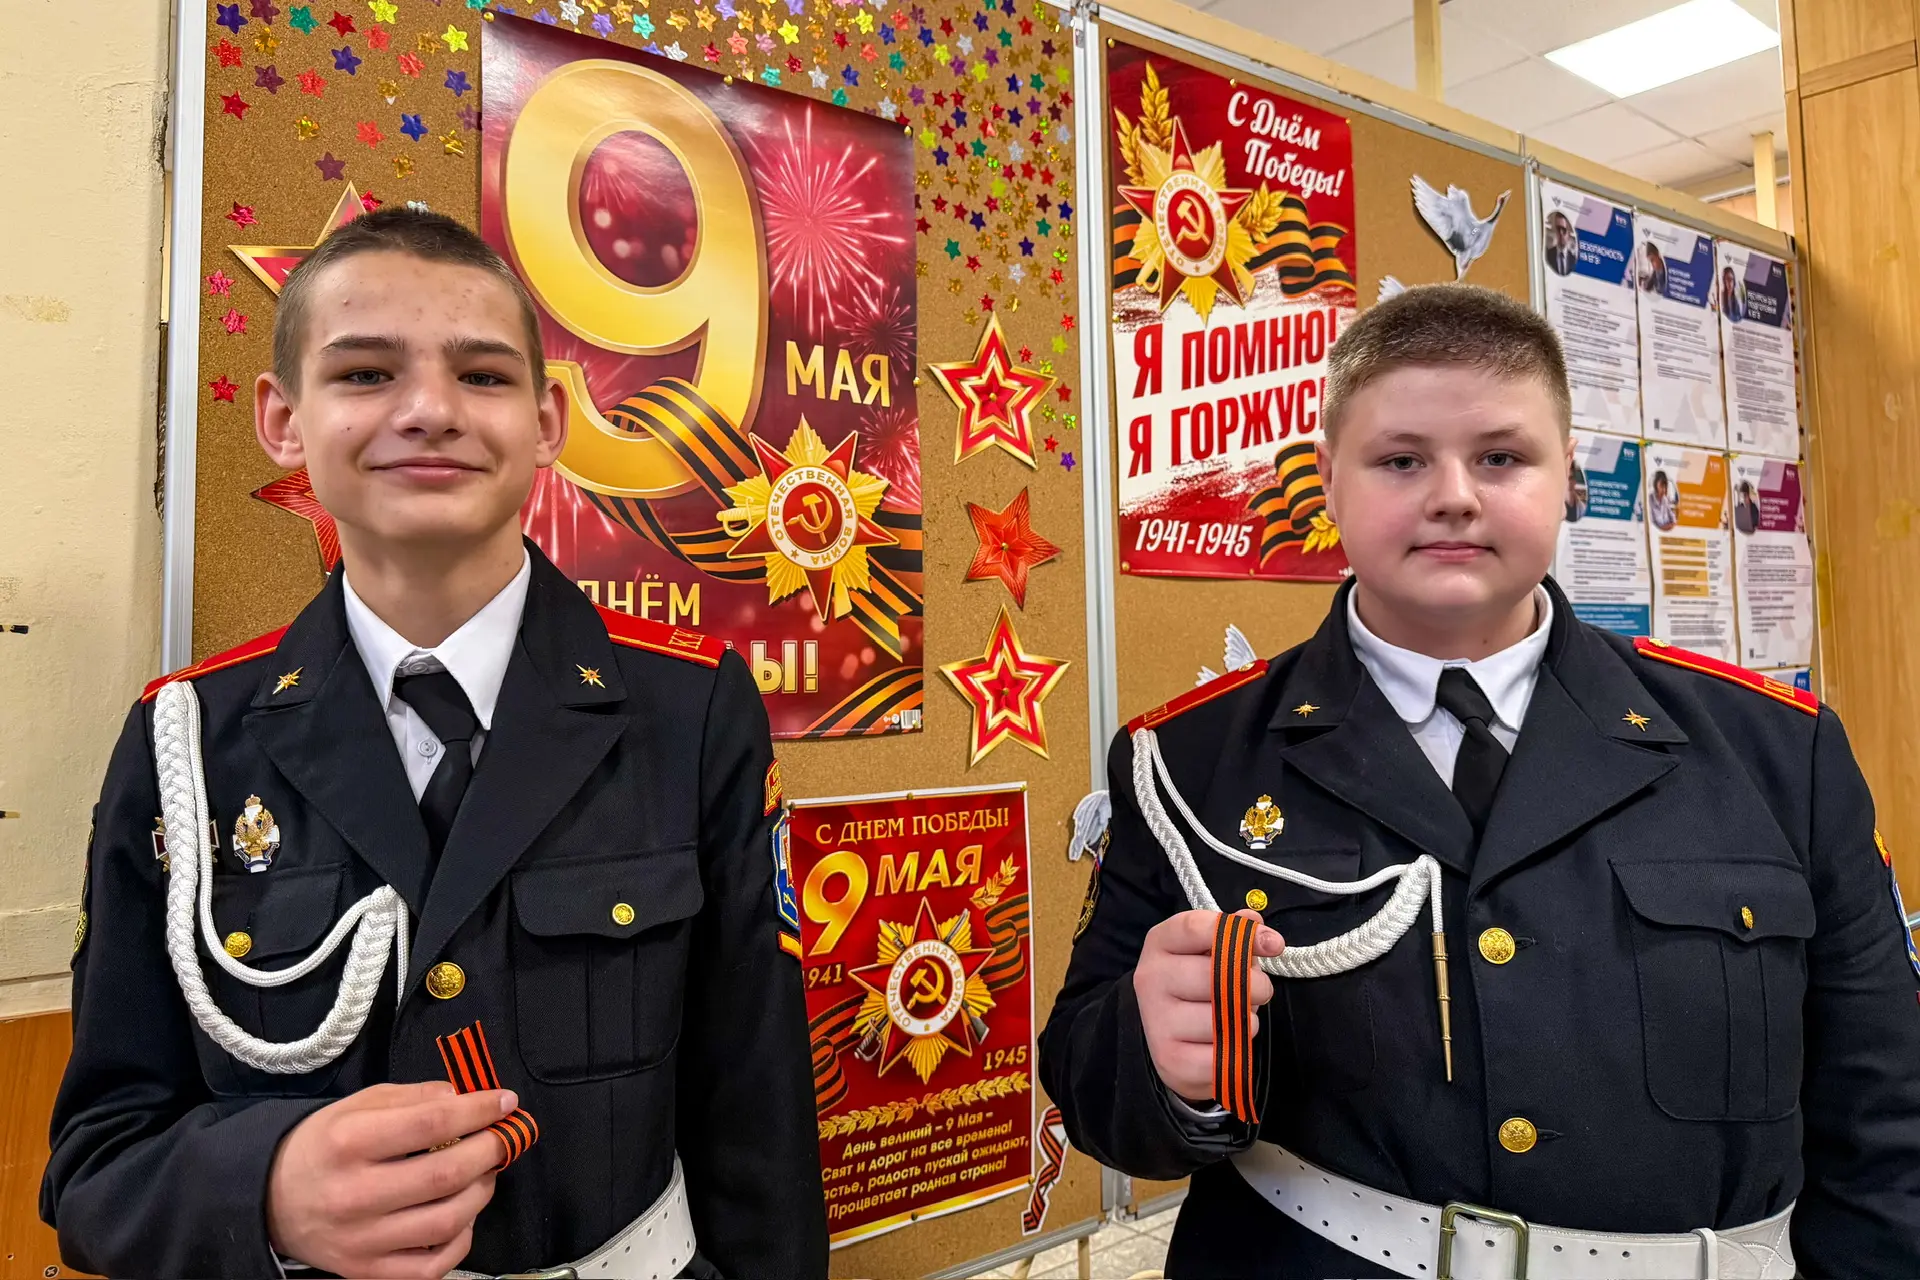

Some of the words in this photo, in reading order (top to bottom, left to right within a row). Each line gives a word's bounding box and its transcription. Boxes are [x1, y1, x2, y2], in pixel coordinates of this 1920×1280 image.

[1227, 91, 1249, 127] С
[1250, 99, 1322, 151] Днём
[1245, 138, 1345, 199] Победы!
[1157, 176, 1217, 268] ОТЕЧЕСТВЕННАЯ
[502, 57, 769, 497] 9
[785, 340, 891, 407] МАЯ
[1132, 323, 1163, 398] Я
[1181, 307, 1336, 390] ПОМНЮ!
[1128, 414, 1151, 478] Я
[771, 469, 854, 541] ОТЕЧЕСТВЕННАЯ
[811, 527, 852, 566] ВОЙНА
[1134, 518, 1254, 558] 1941-1945
[815, 823, 833, 844] С
[838, 817, 905, 847] ДНЕМ
[912, 807, 1010, 836] ПОБЕДЫ!
[802, 850, 869, 957] 9
[875, 844, 984, 897] МАЯ
[802, 963, 843, 989] 941
[888, 943, 957, 1027] ОТЕЧЕСТВЕННАЯ
[940, 968, 964, 1021] ВОЙНА
[983, 1045, 1028, 1071] 1945
[822, 1164, 853, 1182] Свят
[856, 1161, 866, 1173] и
[868, 1149, 908, 1170] дорог
[910, 1144, 927, 1159] на
[930, 1138, 953, 1153] все
[956, 1119, 1013, 1148] времена!
[842, 1142, 877, 1160] День
[880, 1123, 932, 1148] великий
[946, 1117, 954, 1131] 9
[957, 1111, 983, 1128] Мая
[867, 1166, 921, 1192] радость
[924, 1149, 969, 1174] пускай
[971, 1135, 1029, 1160] ожидают,
[828, 1186, 908, 1220] Процветает
[911, 1172, 957, 1198] родная
[960, 1155, 1008, 1181] страна!
